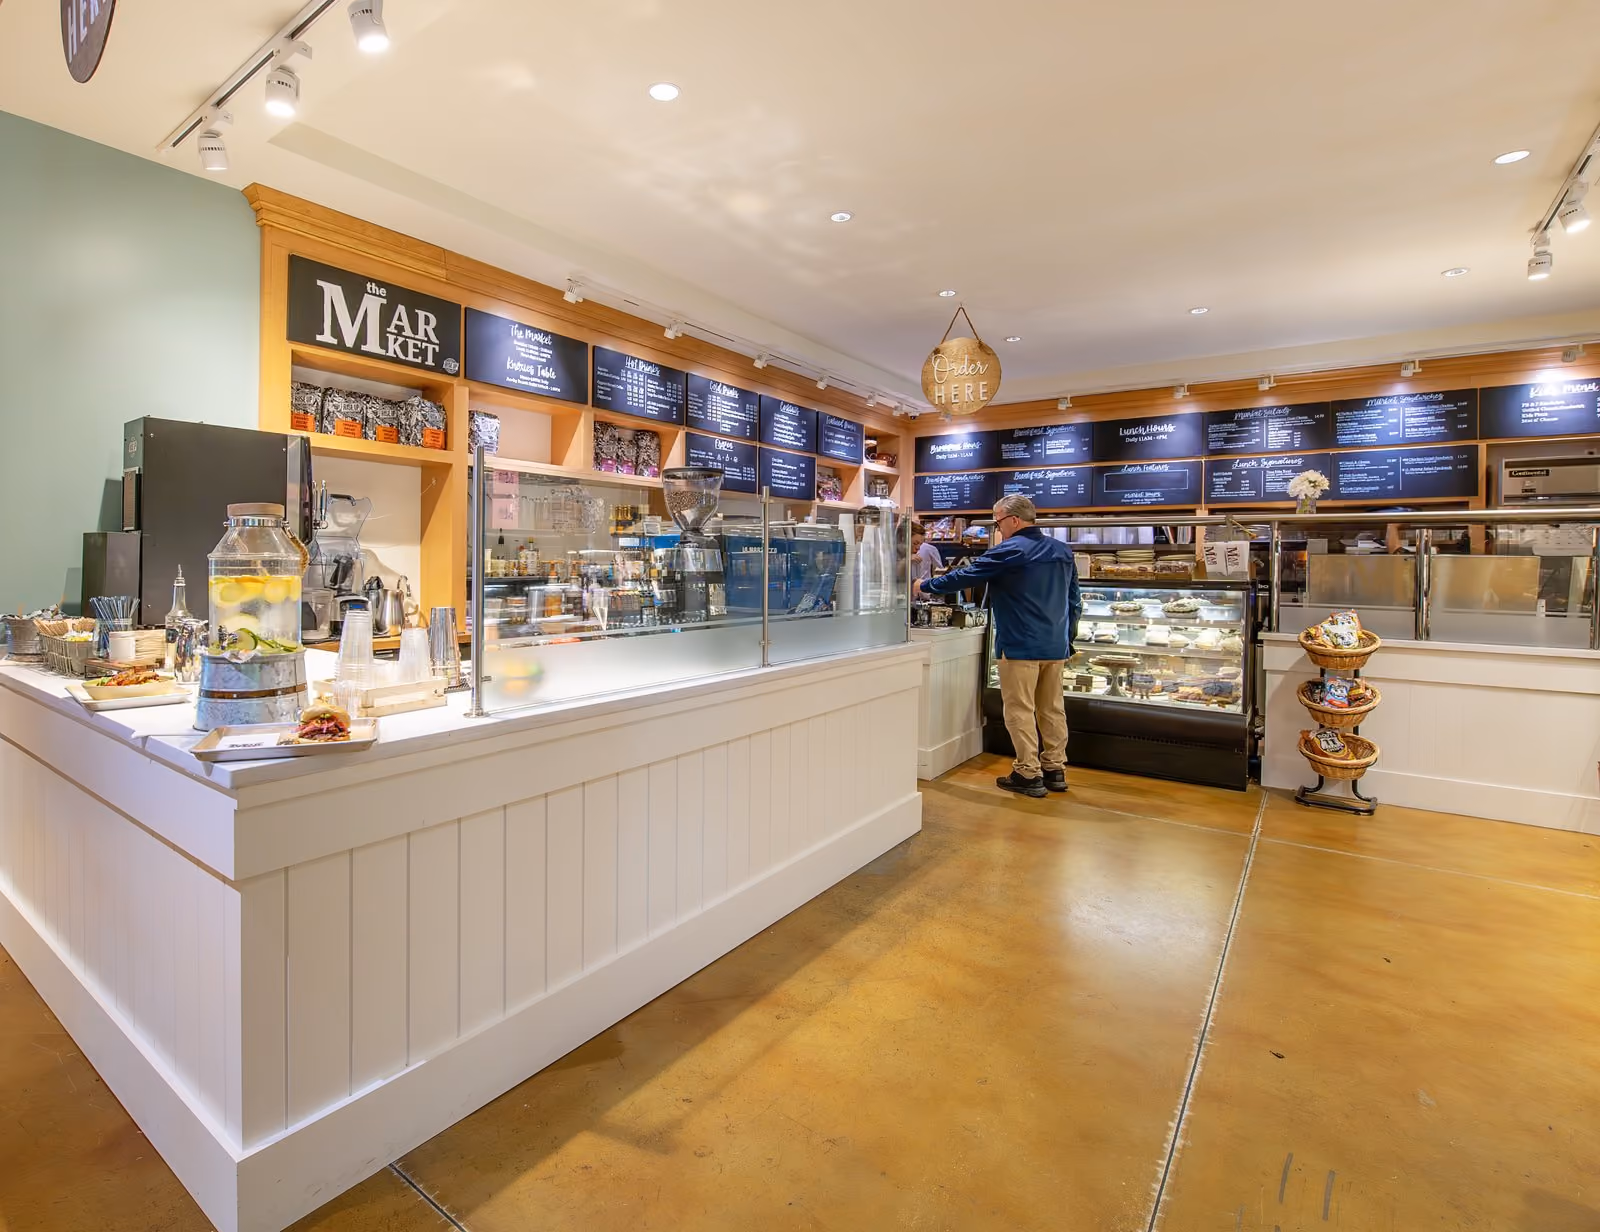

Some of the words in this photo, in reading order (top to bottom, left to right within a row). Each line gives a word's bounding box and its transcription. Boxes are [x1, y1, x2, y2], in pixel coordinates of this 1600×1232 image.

[366, 281, 387, 297] the
[509, 324, 524, 339] The
[525, 328, 552, 345] Market
[537, 365, 556, 379] Table
[626, 356, 638, 369] Hot
[639, 360, 661, 376] Drinks
[932, 354, 988, 383] Order
[710, 380, 722, 394] Cold
[723, 385, 740, 398] Drinks
[935, 382, 988, 404] HERE
[1119, 426, 1146, 436] Lunch
[1146, 424, 1177, 433] Hours
[1232, 459, 1259, 469] Lunch
[1260, 457, 1305, 468] Signatures
[1013, 471, 1045, 480] Breakfast
